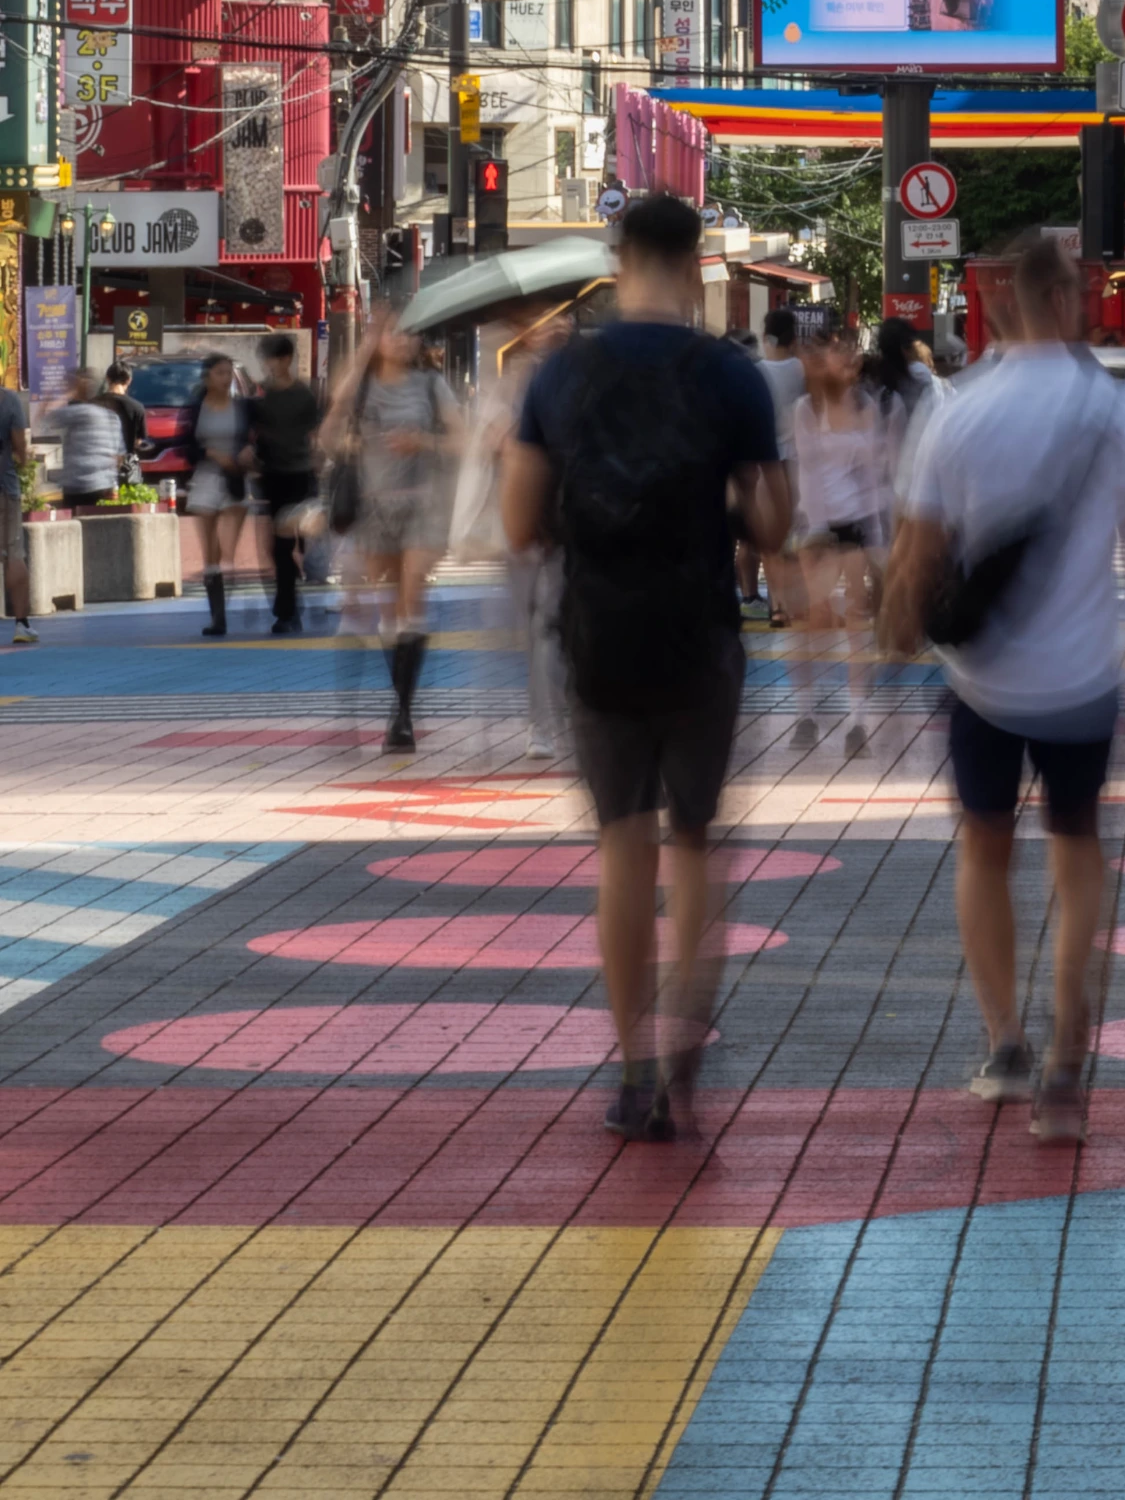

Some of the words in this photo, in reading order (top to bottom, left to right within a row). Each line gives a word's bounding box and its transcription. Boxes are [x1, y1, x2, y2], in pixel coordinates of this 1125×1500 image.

[670, 0, 694, 12] 무인
[77, 75, 118, 101] 3F
[231, 117, 267, 149] JAM
[142, 222, 179, 254] JAM
